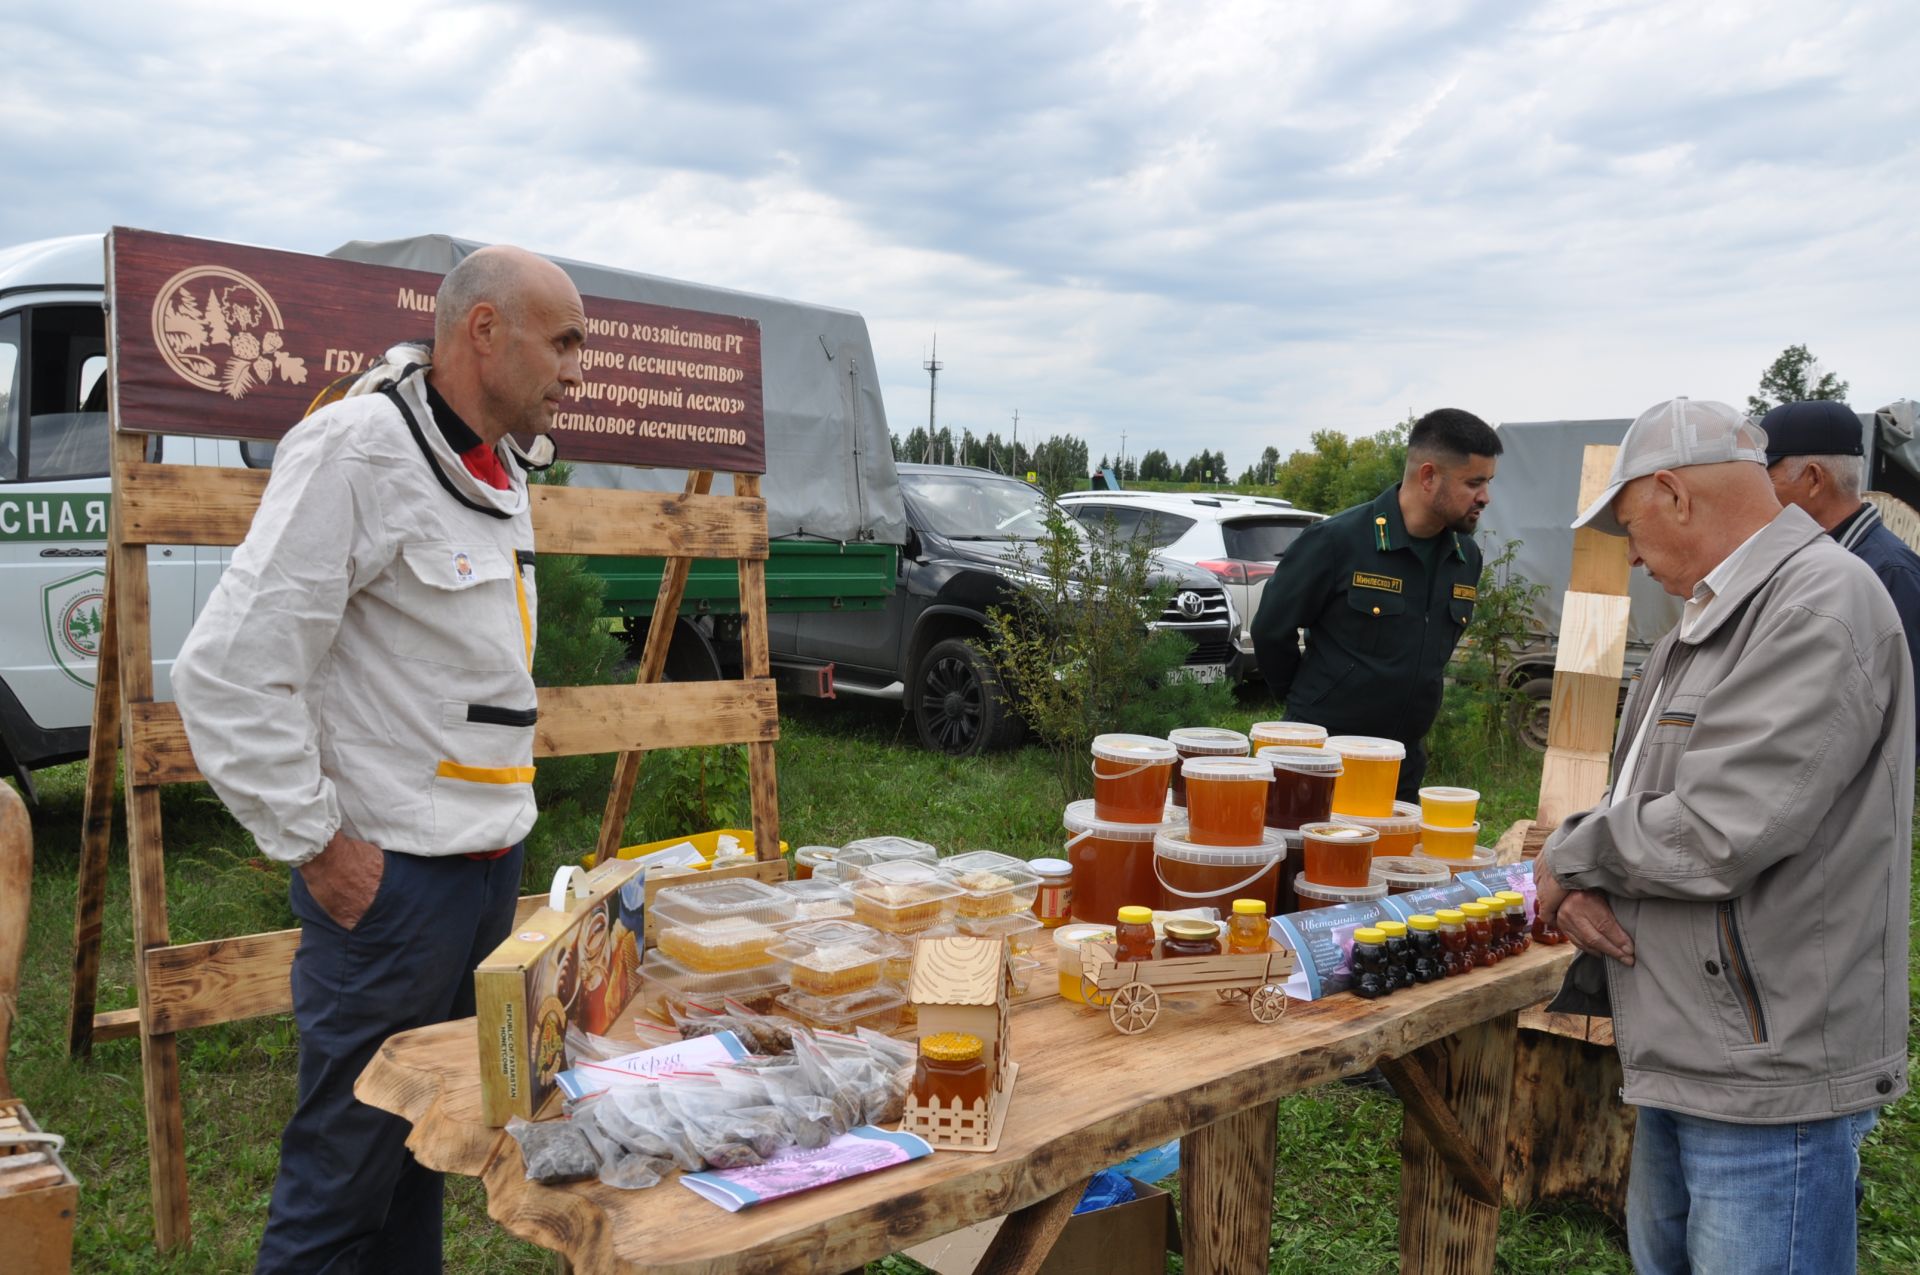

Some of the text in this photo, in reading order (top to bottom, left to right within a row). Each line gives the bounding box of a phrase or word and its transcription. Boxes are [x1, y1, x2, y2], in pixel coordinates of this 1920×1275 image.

[632, 324, 722, 352] хозяйства
[726, 334, 744, 355] РТ
[324, 348, 364, 374] ГБУ
[628, 355, 744, 384] лесничество»
[686, 393, 745, 414] лесхоз»
[552, 412, 746, 446] стковое лесничество
[0, 500, 106, 534] СНАЯ
[506, 1003, 514, 1041] REPUBLIC
[509, 1055, 517, 1098] TATARSTAN
